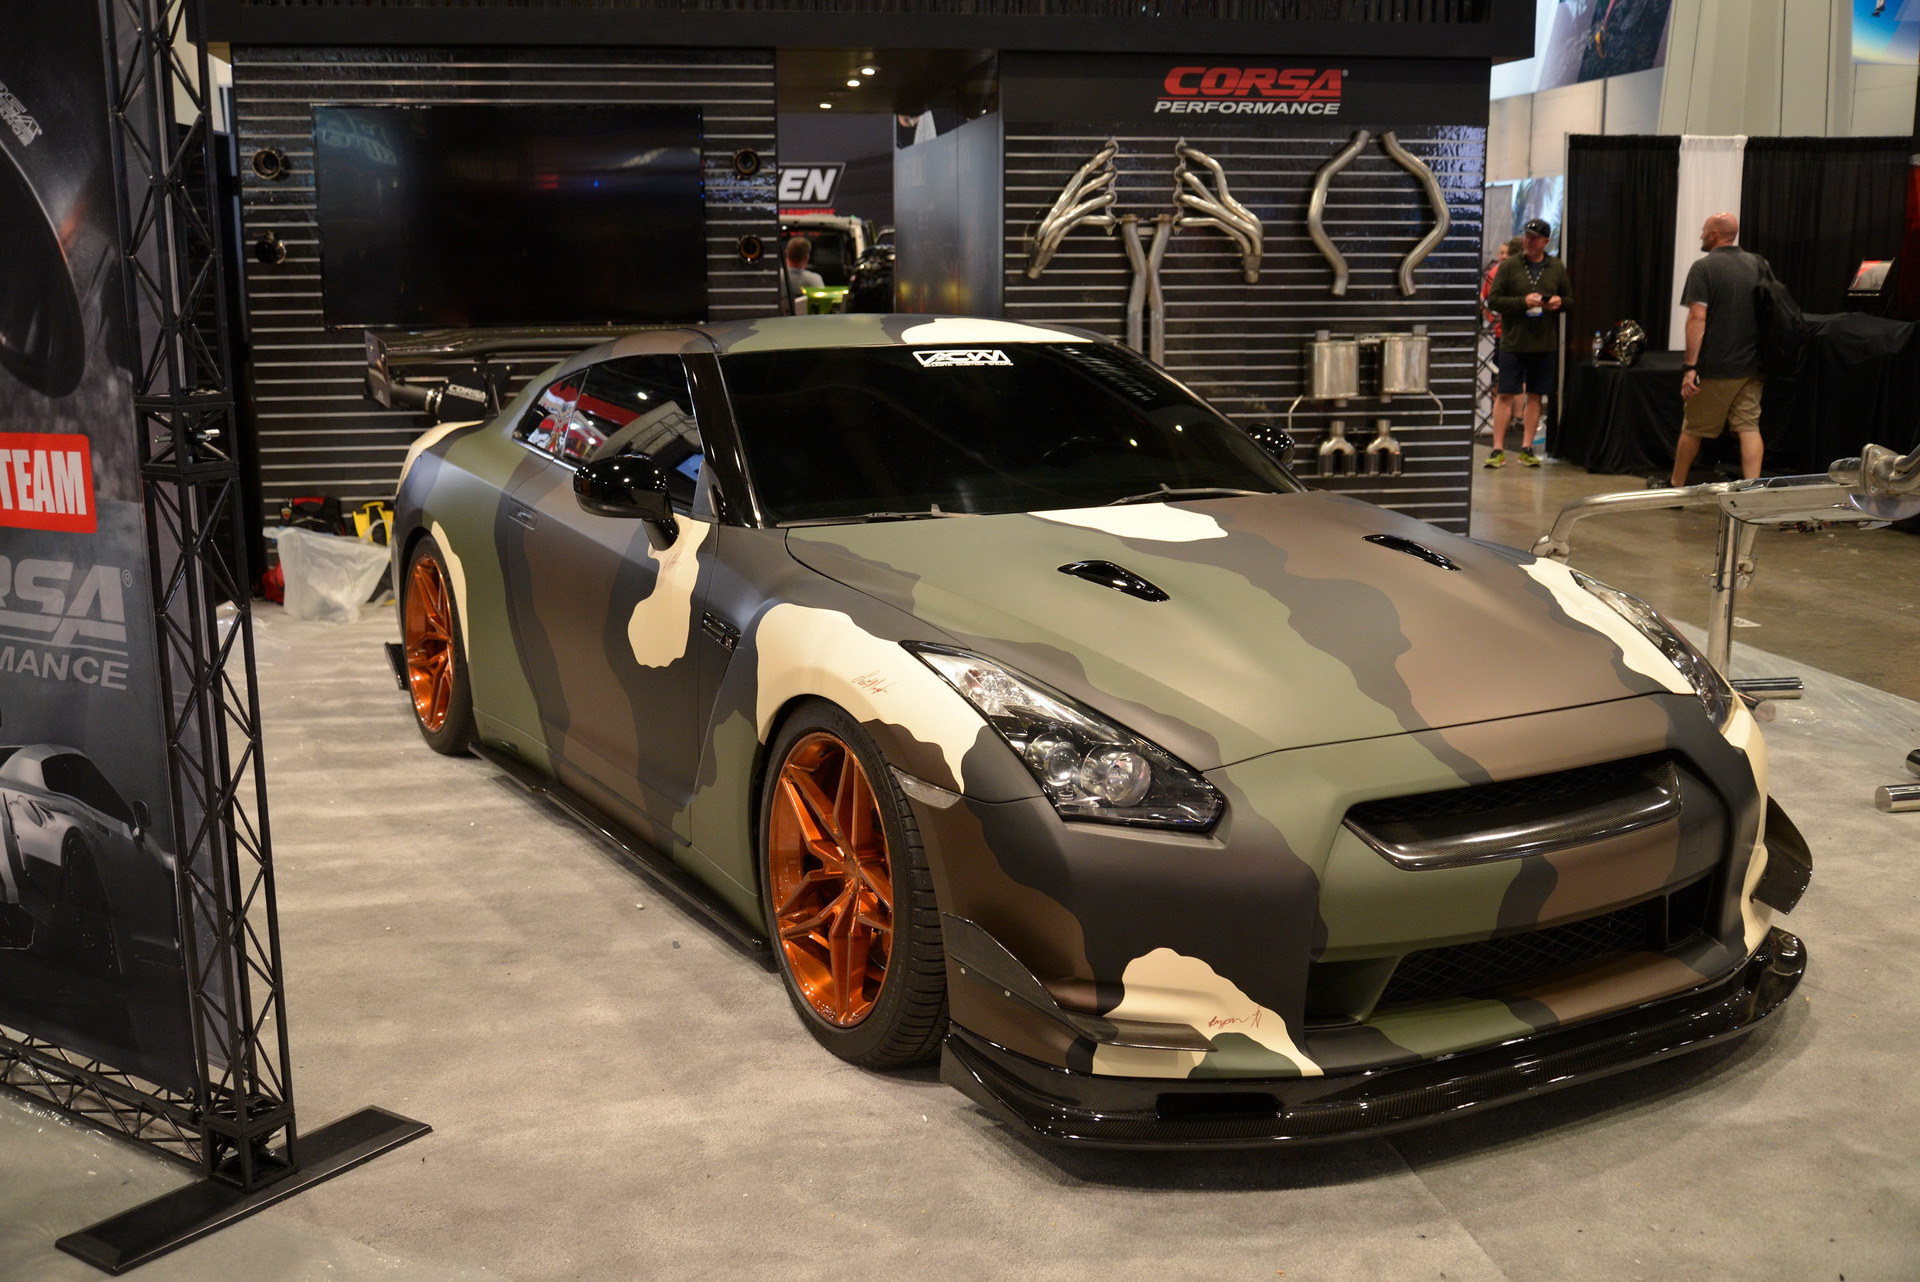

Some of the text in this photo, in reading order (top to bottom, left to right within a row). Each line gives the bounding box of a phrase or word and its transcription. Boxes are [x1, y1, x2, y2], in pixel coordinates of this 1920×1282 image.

[1154, 101, 1341, 115] PERFORMANCE
[778, 168, 837, 201] EN
[0, 555, 127, 647] SA
